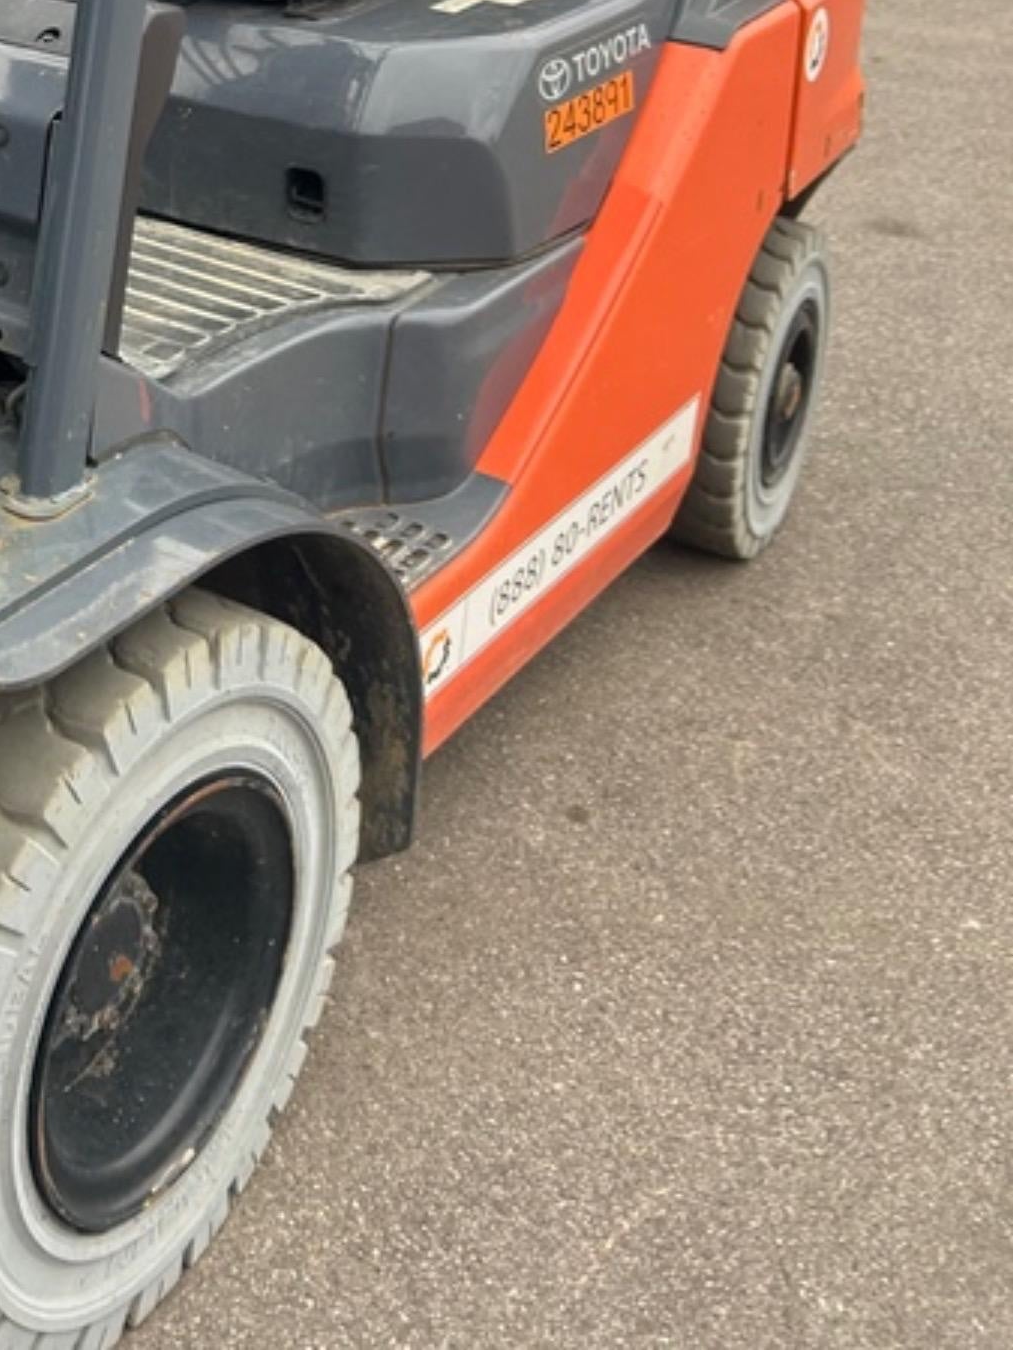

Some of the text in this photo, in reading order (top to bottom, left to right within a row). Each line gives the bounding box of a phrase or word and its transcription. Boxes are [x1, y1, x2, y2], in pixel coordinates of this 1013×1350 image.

[572, 22, 652, 82] TOYOTA
[547, 75, 631, 148] 243891
[489, 548, 547, 627] (888)
